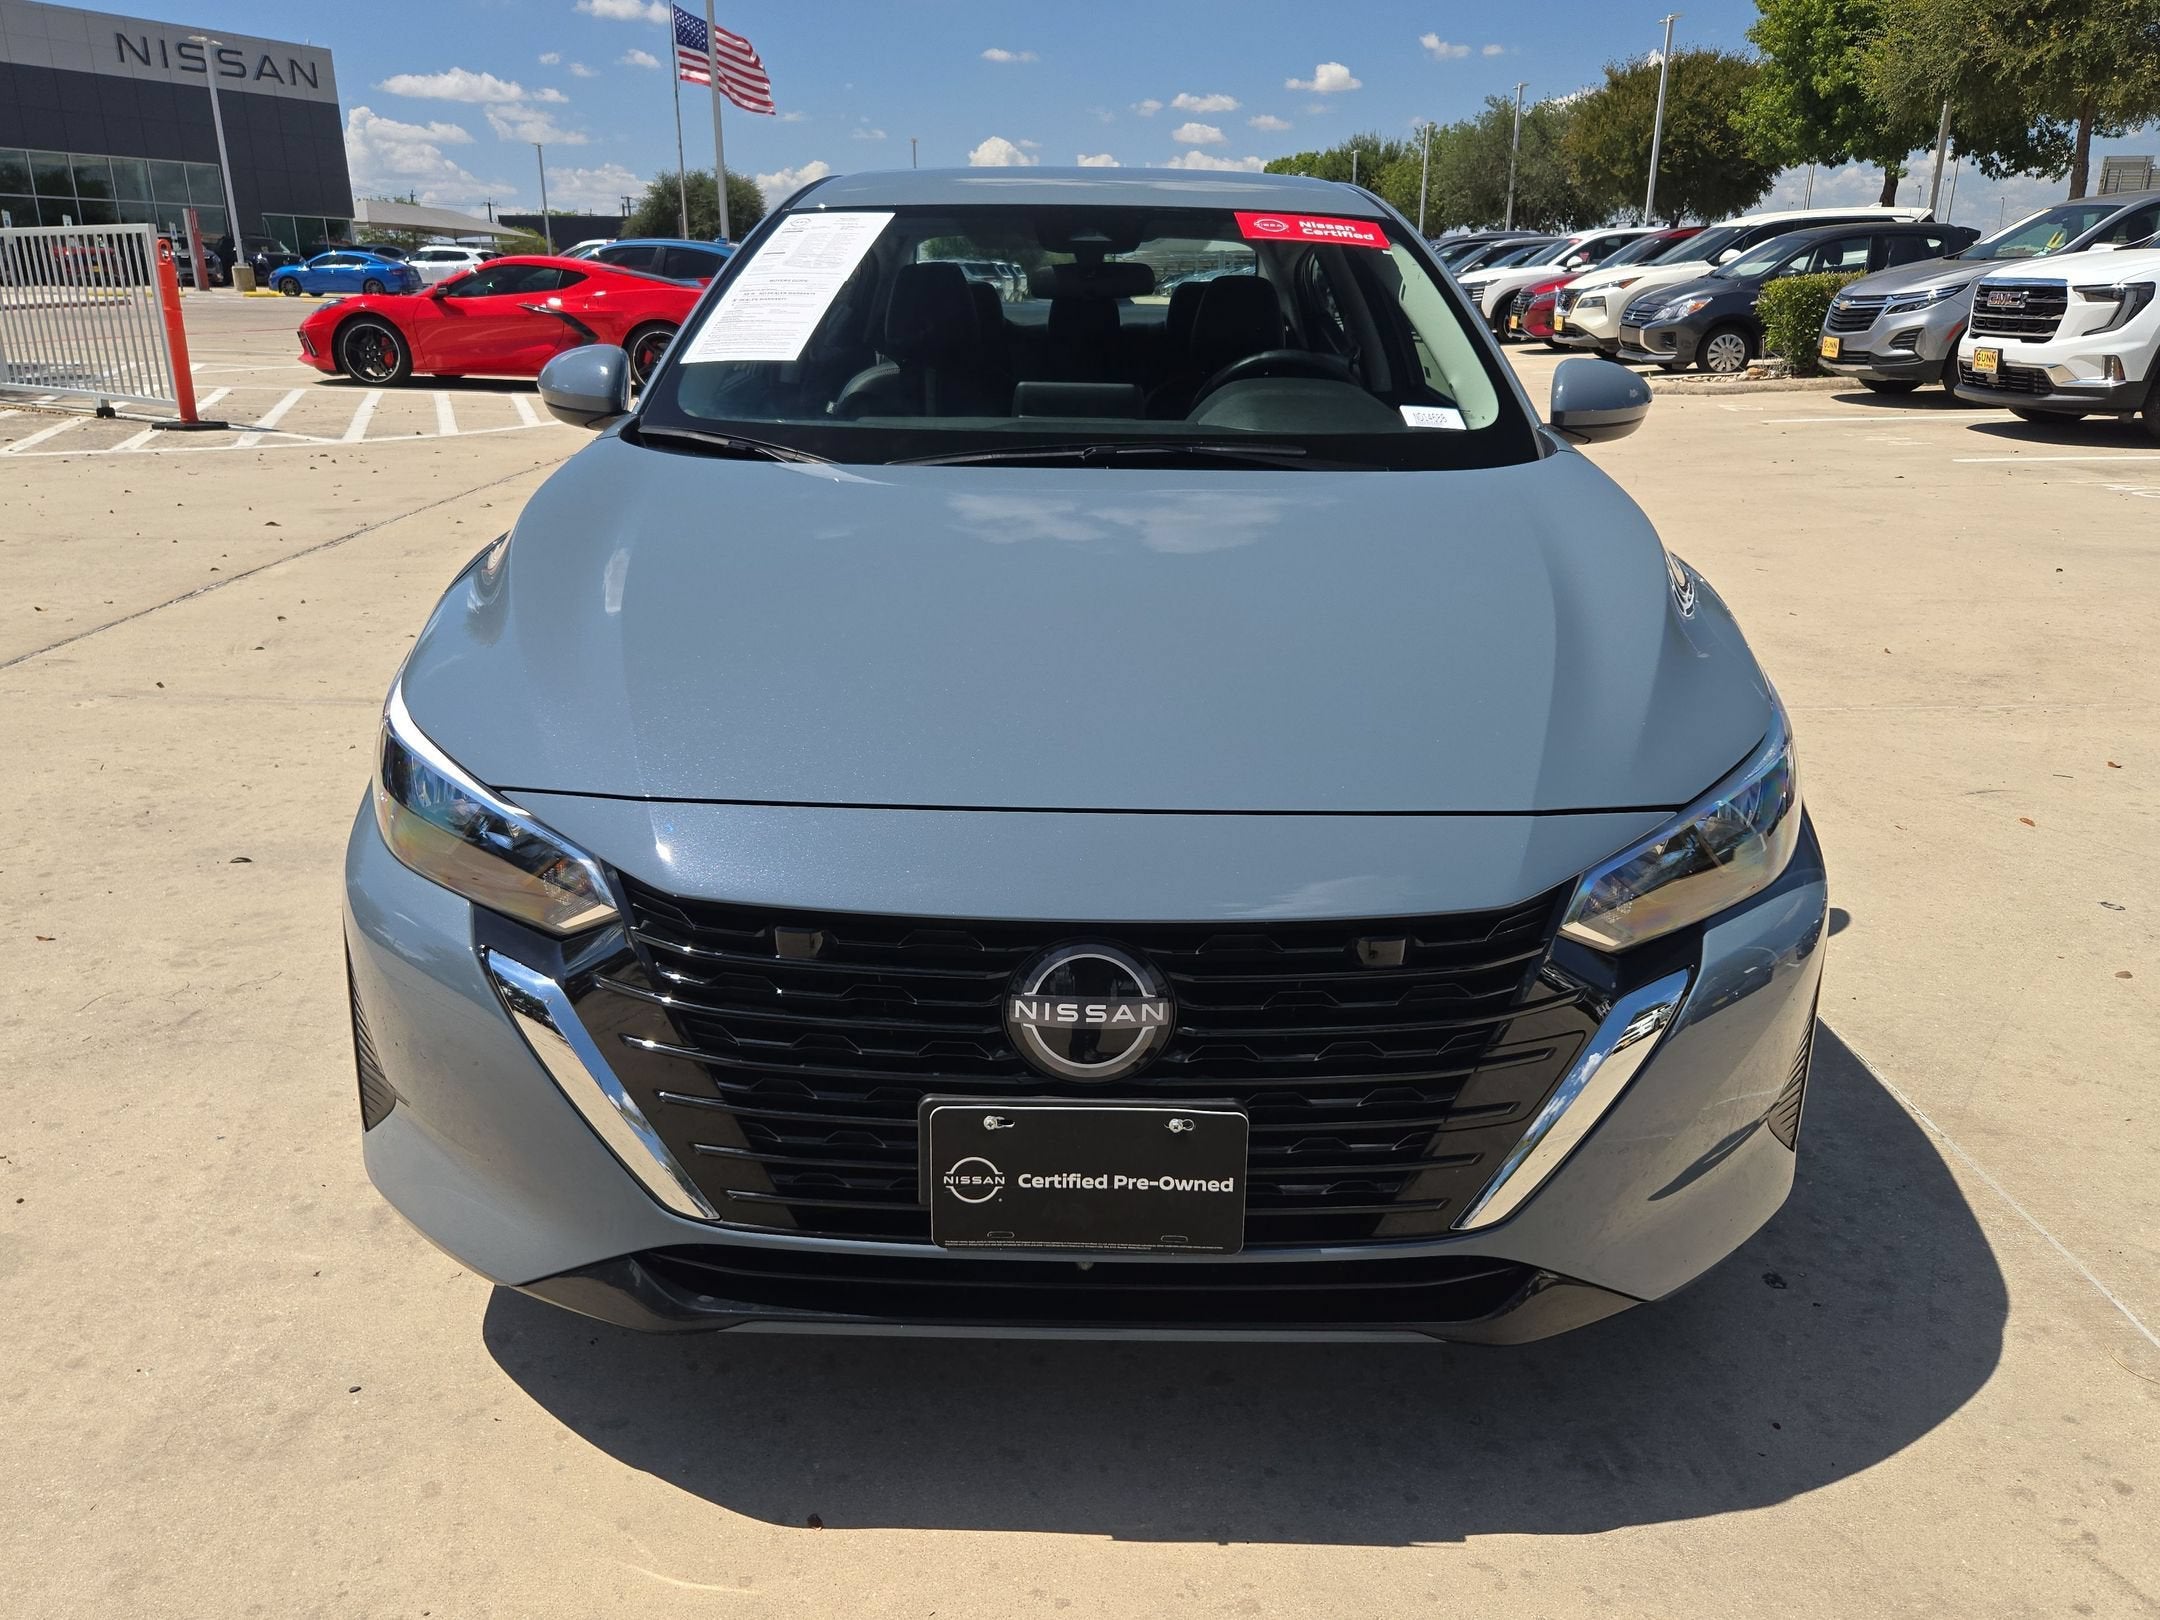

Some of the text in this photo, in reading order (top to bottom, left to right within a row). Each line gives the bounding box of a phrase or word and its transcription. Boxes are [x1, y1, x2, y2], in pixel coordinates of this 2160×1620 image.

[115, 32, 319, 89] NISSAN
[1299, 221, 1356, 231] Nissan
[1302, 228, 1375, 241] Certified
[1989, 293, 2021, 306] GMC
[1976, 352, 1997, 363] GUNN
[1014, 1000, 1164, 1023] NISSAN
[943, 1173, 1234, 1193] NISSAN Certified Pre-Owned
